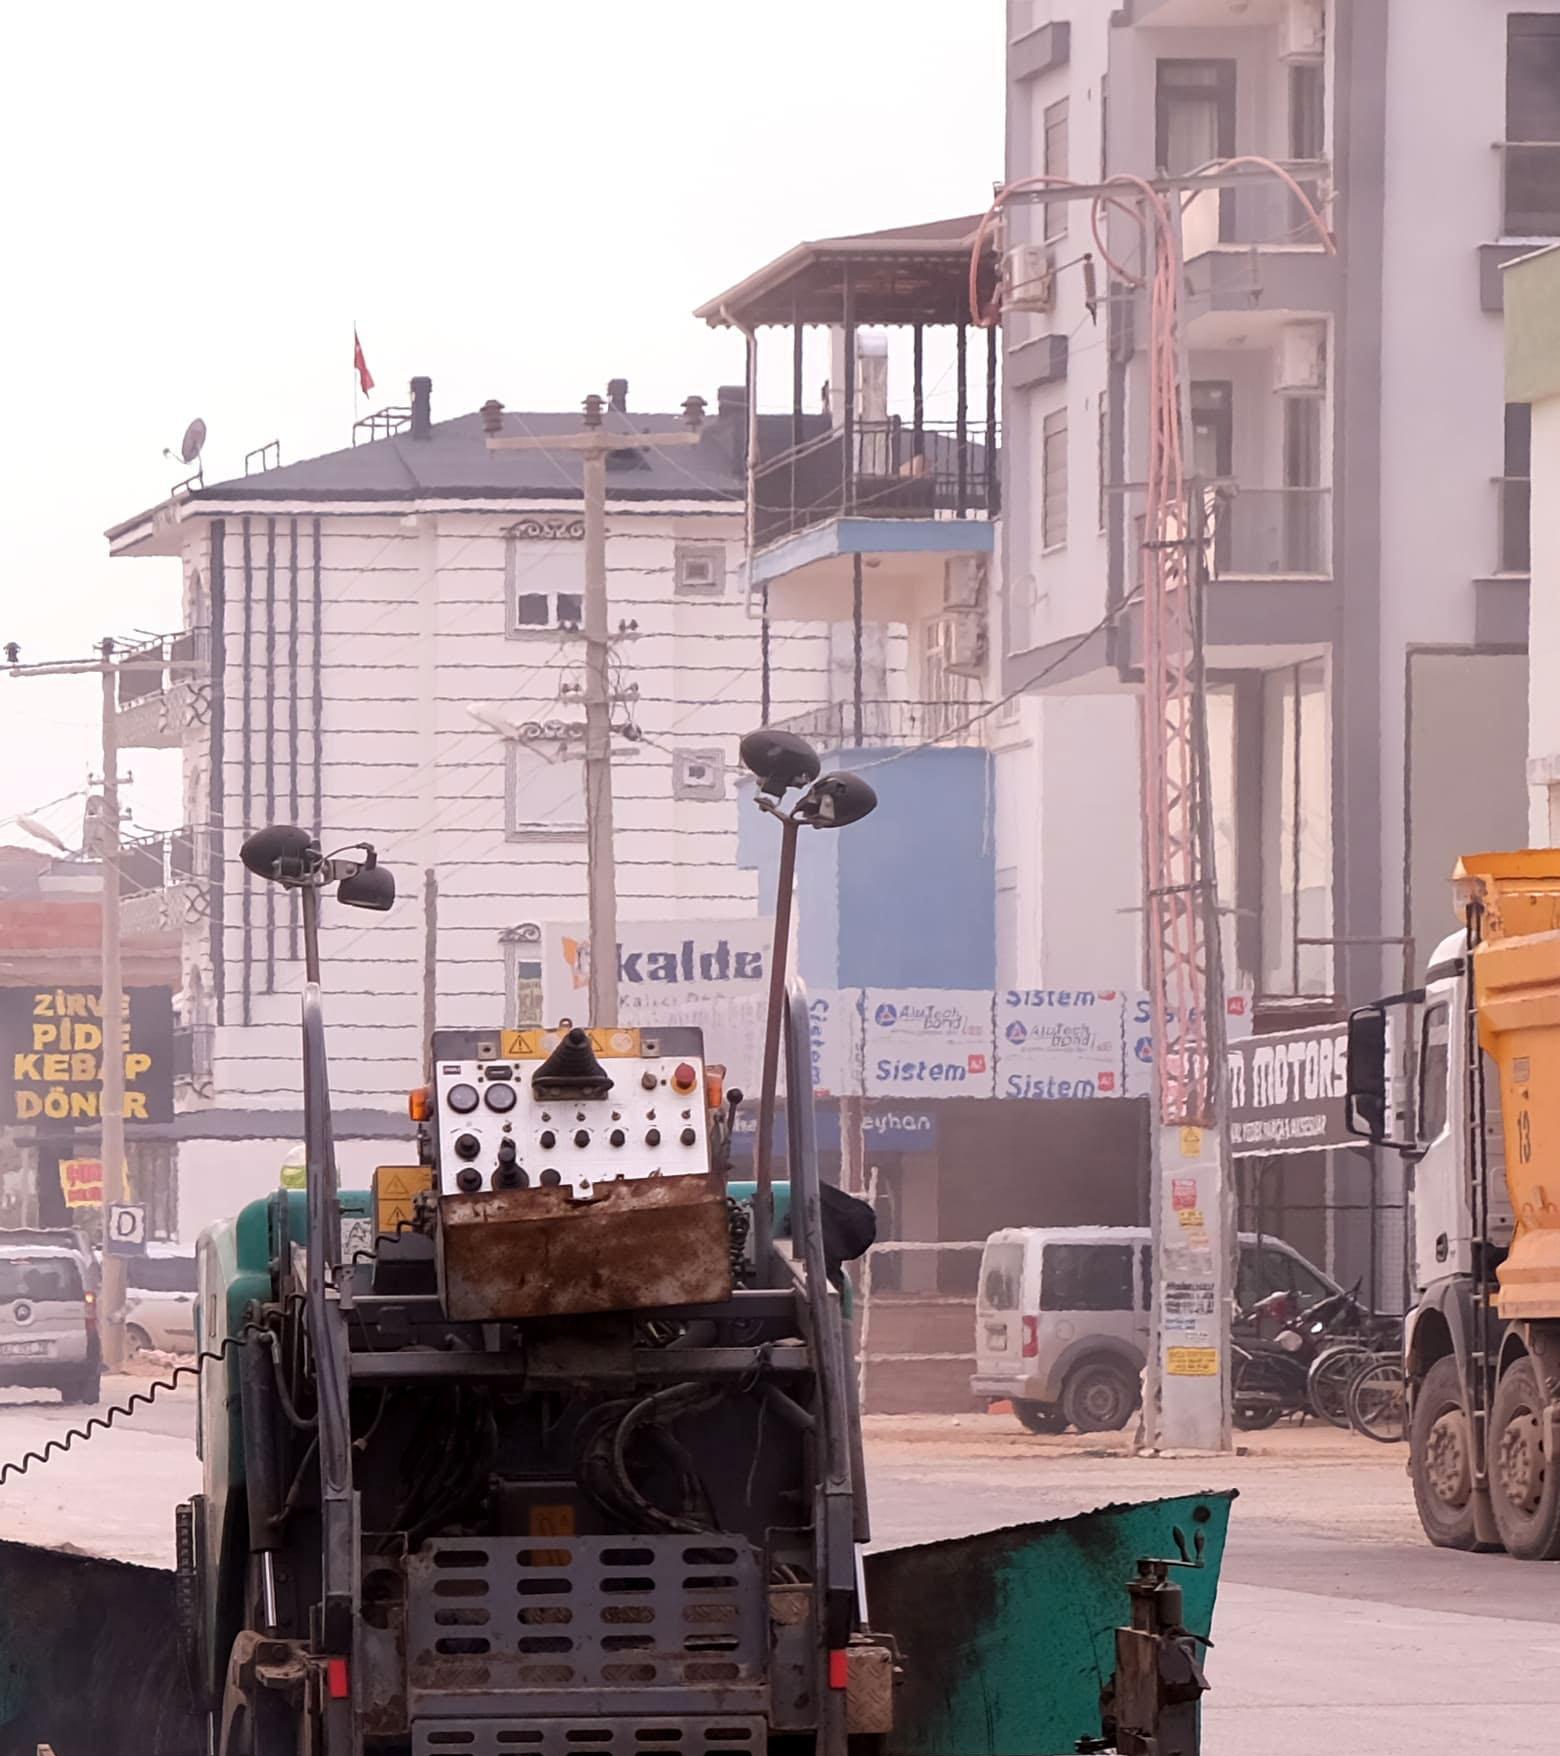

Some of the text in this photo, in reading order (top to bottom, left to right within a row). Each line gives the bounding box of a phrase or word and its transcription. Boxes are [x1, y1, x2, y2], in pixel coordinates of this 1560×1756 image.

[615, 939, 763, 983] kalde
[14, 1053, 152, 1080] KEBP
[875, 1058, 966, 1082] Sistem
[1252, 1035, 1348, 1107] MOTORS
[1006, 1074, 1095, 1099] Sistem
[16, 1086, 149, 1119] DÖNR
[842, 1112, 931, 1133] eyhan
[117, 1210, 137, 1237] D
